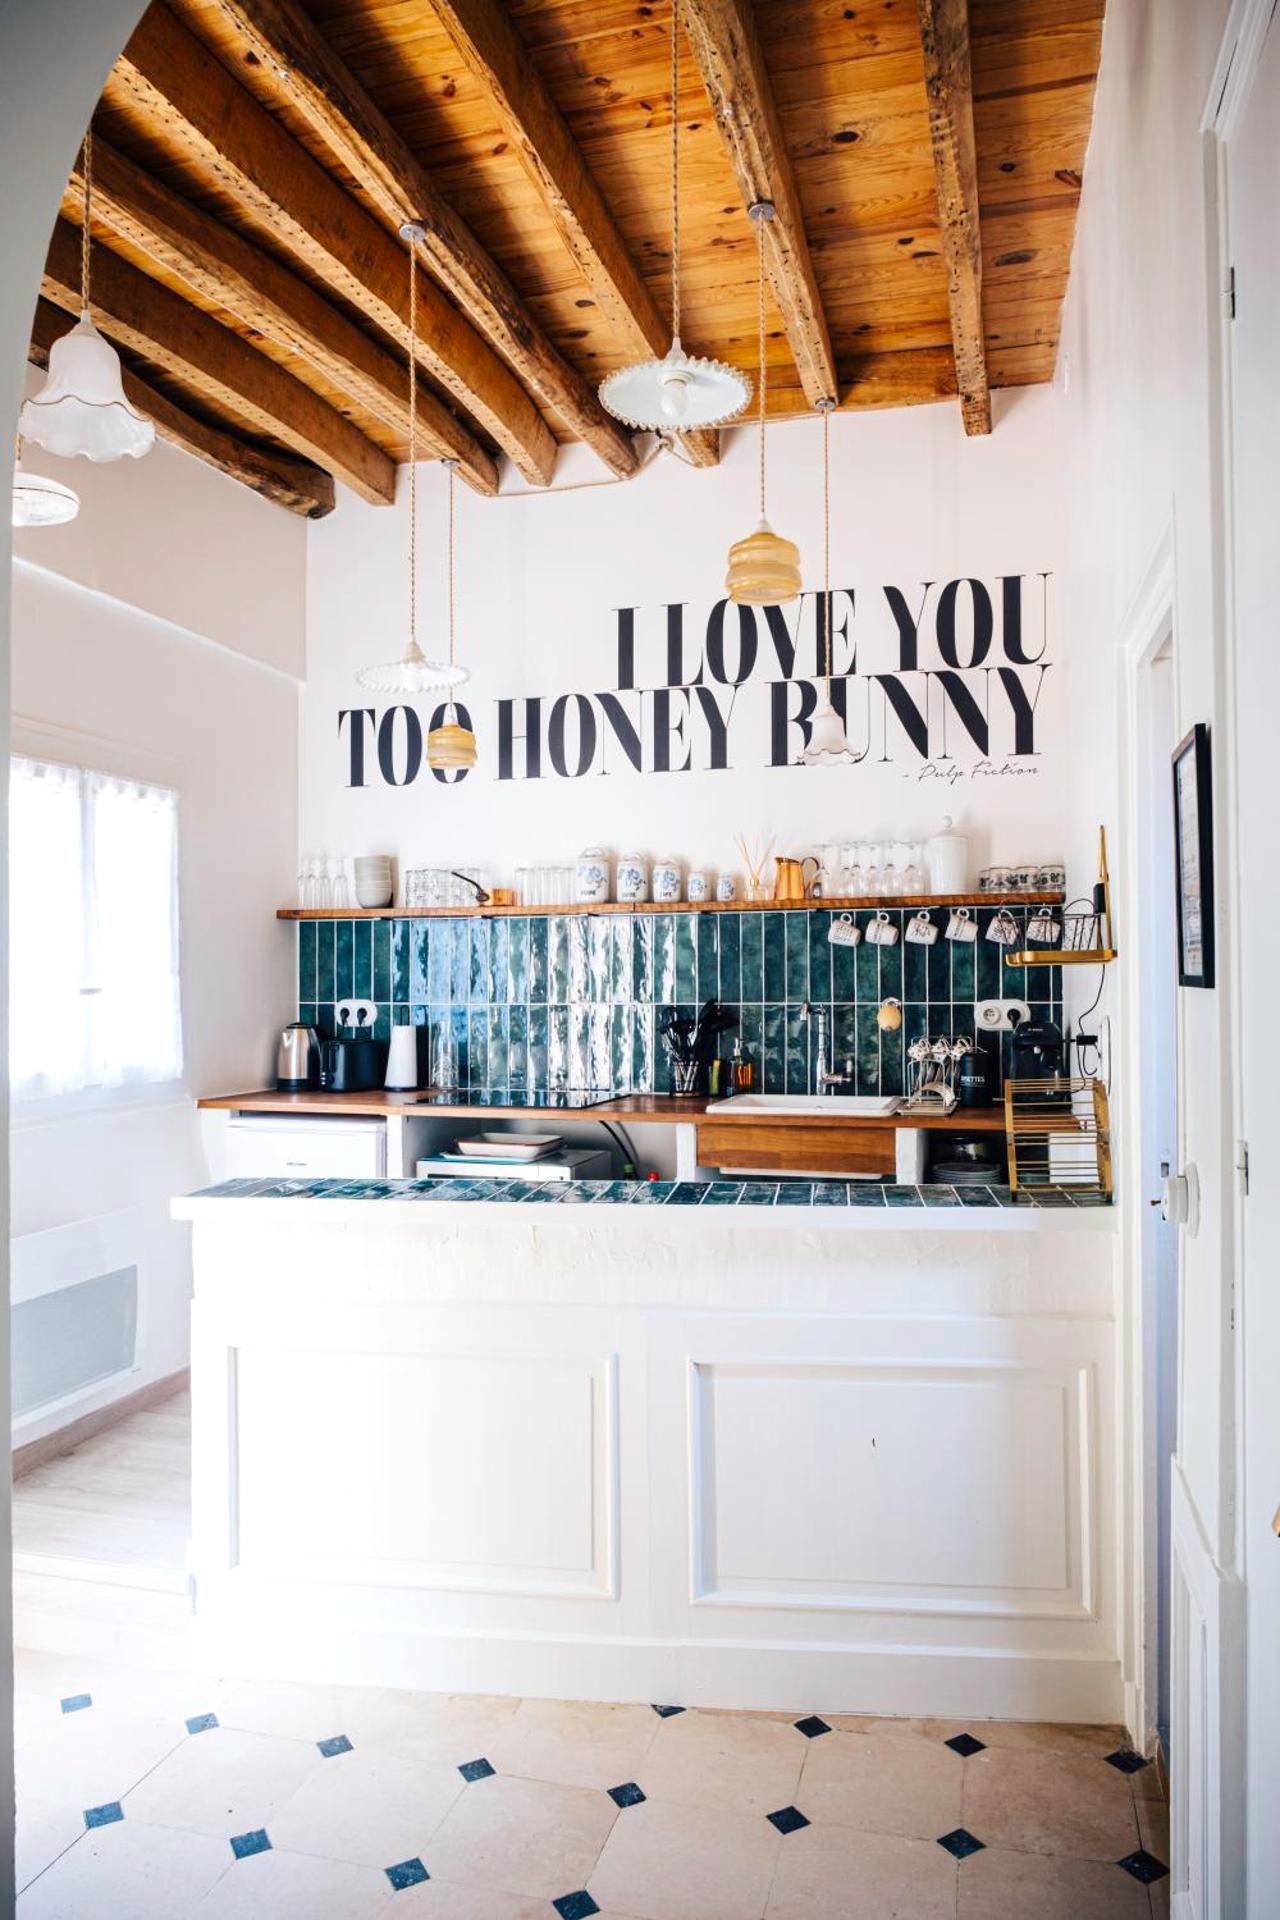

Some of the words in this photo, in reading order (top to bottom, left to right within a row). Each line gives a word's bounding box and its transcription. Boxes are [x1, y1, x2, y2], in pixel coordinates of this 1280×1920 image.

[611, 606, 642, 690] I
[660, 589, 857, 684] LOVE
[882, 572, 1053, 672] YOU
[493, 683, 735, 780] HONEY
[918, 763, 964, 785] Pulp
[971, 760, 1039, 779] Fiction
